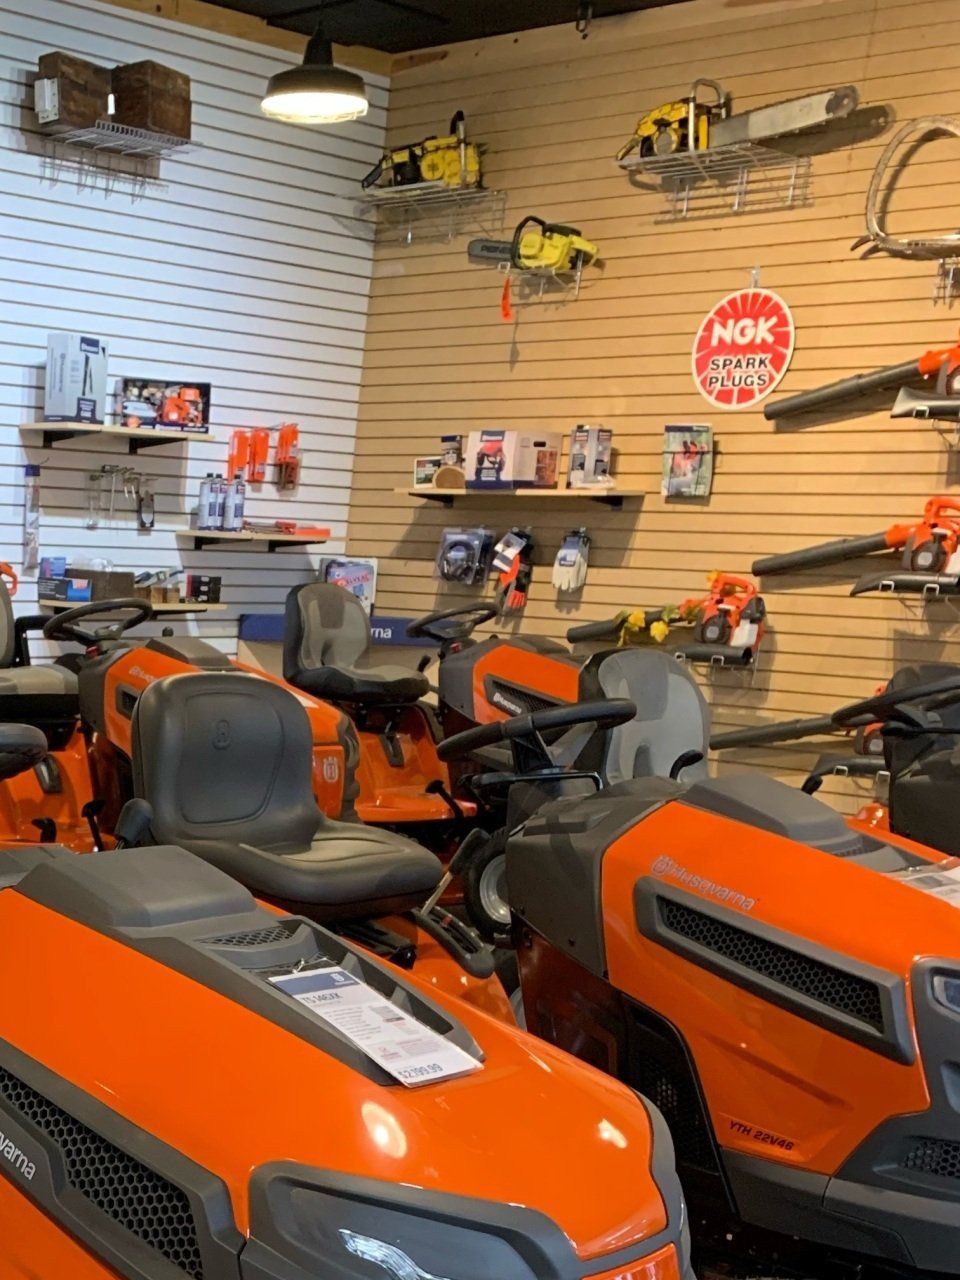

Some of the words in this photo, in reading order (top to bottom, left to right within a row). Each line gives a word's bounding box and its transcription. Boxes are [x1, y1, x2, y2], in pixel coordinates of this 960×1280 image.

[710, 315, 778, 347] NGK
[710, 356, 769, 371] SPARK
[708, 374, 768, 388] PLUGS
[672, 864, 756, 911] Husqvarna
[729, 1120, 752, 1136] YTH
[753, 1130, 795, 1151] 22V46
